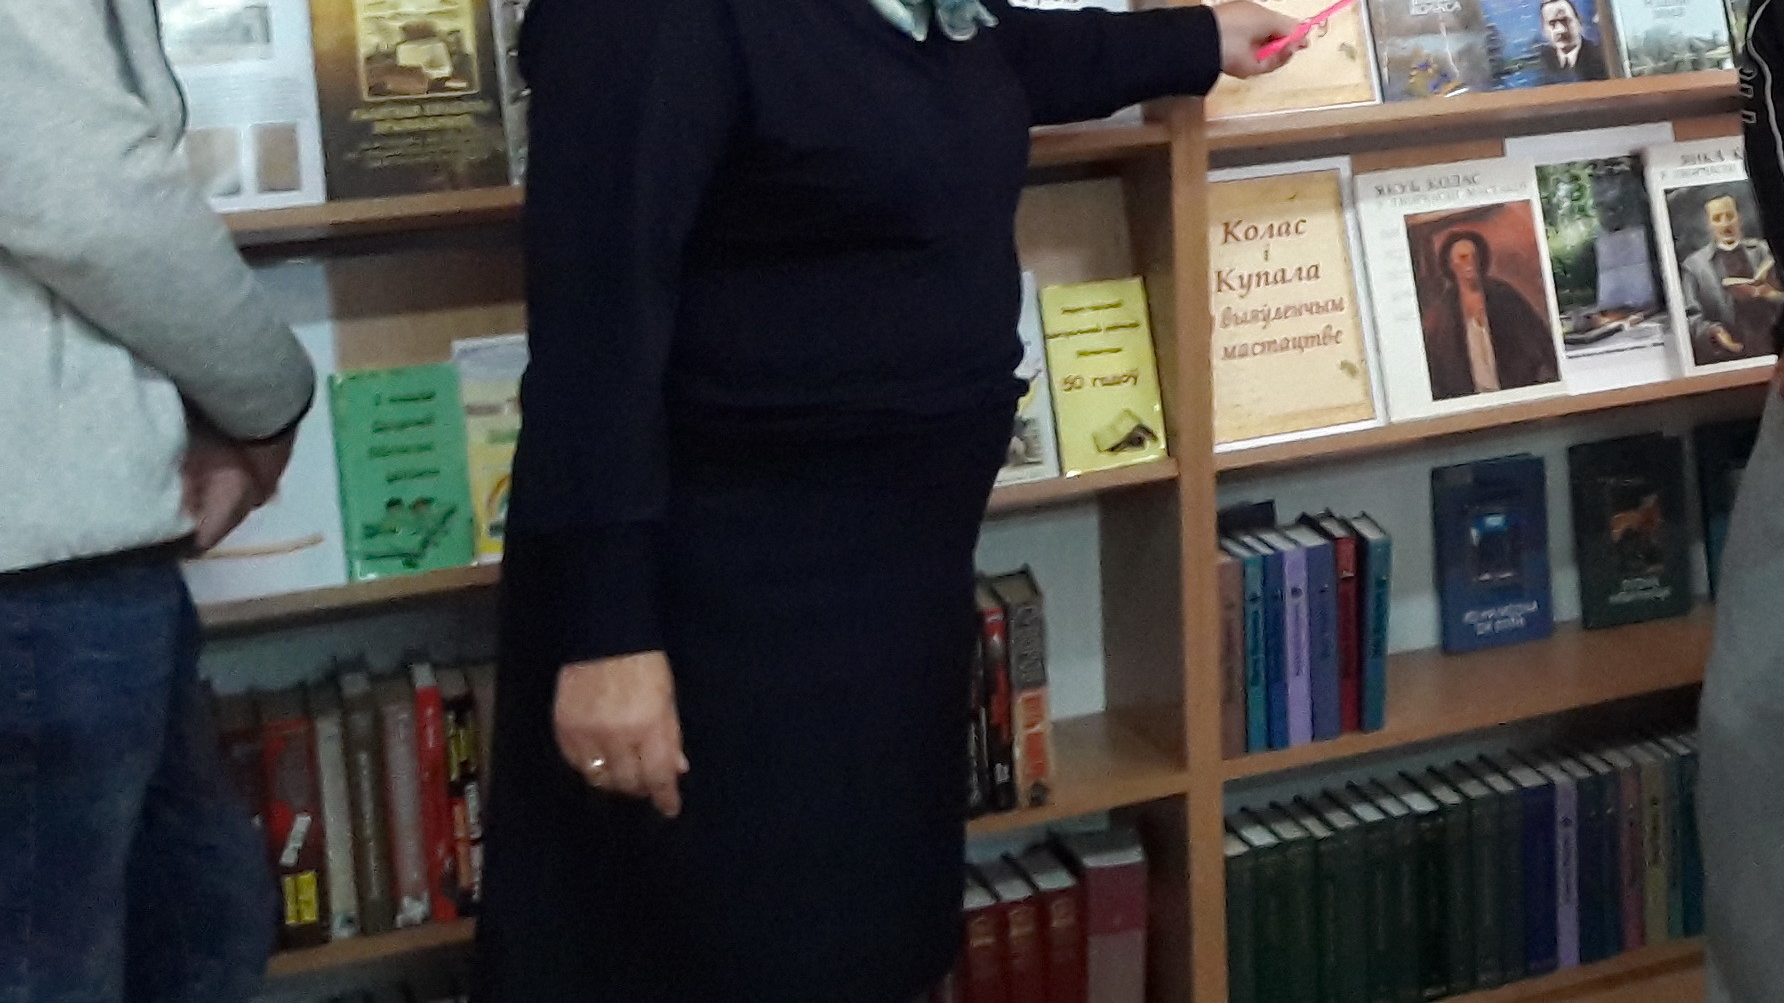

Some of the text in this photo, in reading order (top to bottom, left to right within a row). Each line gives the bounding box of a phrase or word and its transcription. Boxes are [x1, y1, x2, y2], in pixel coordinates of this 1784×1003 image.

[1221, 218, 1308, 245] Колас
[1215, 261, 1322, 299] Купала
[1221, 323, 1344, 361] мастацтве
